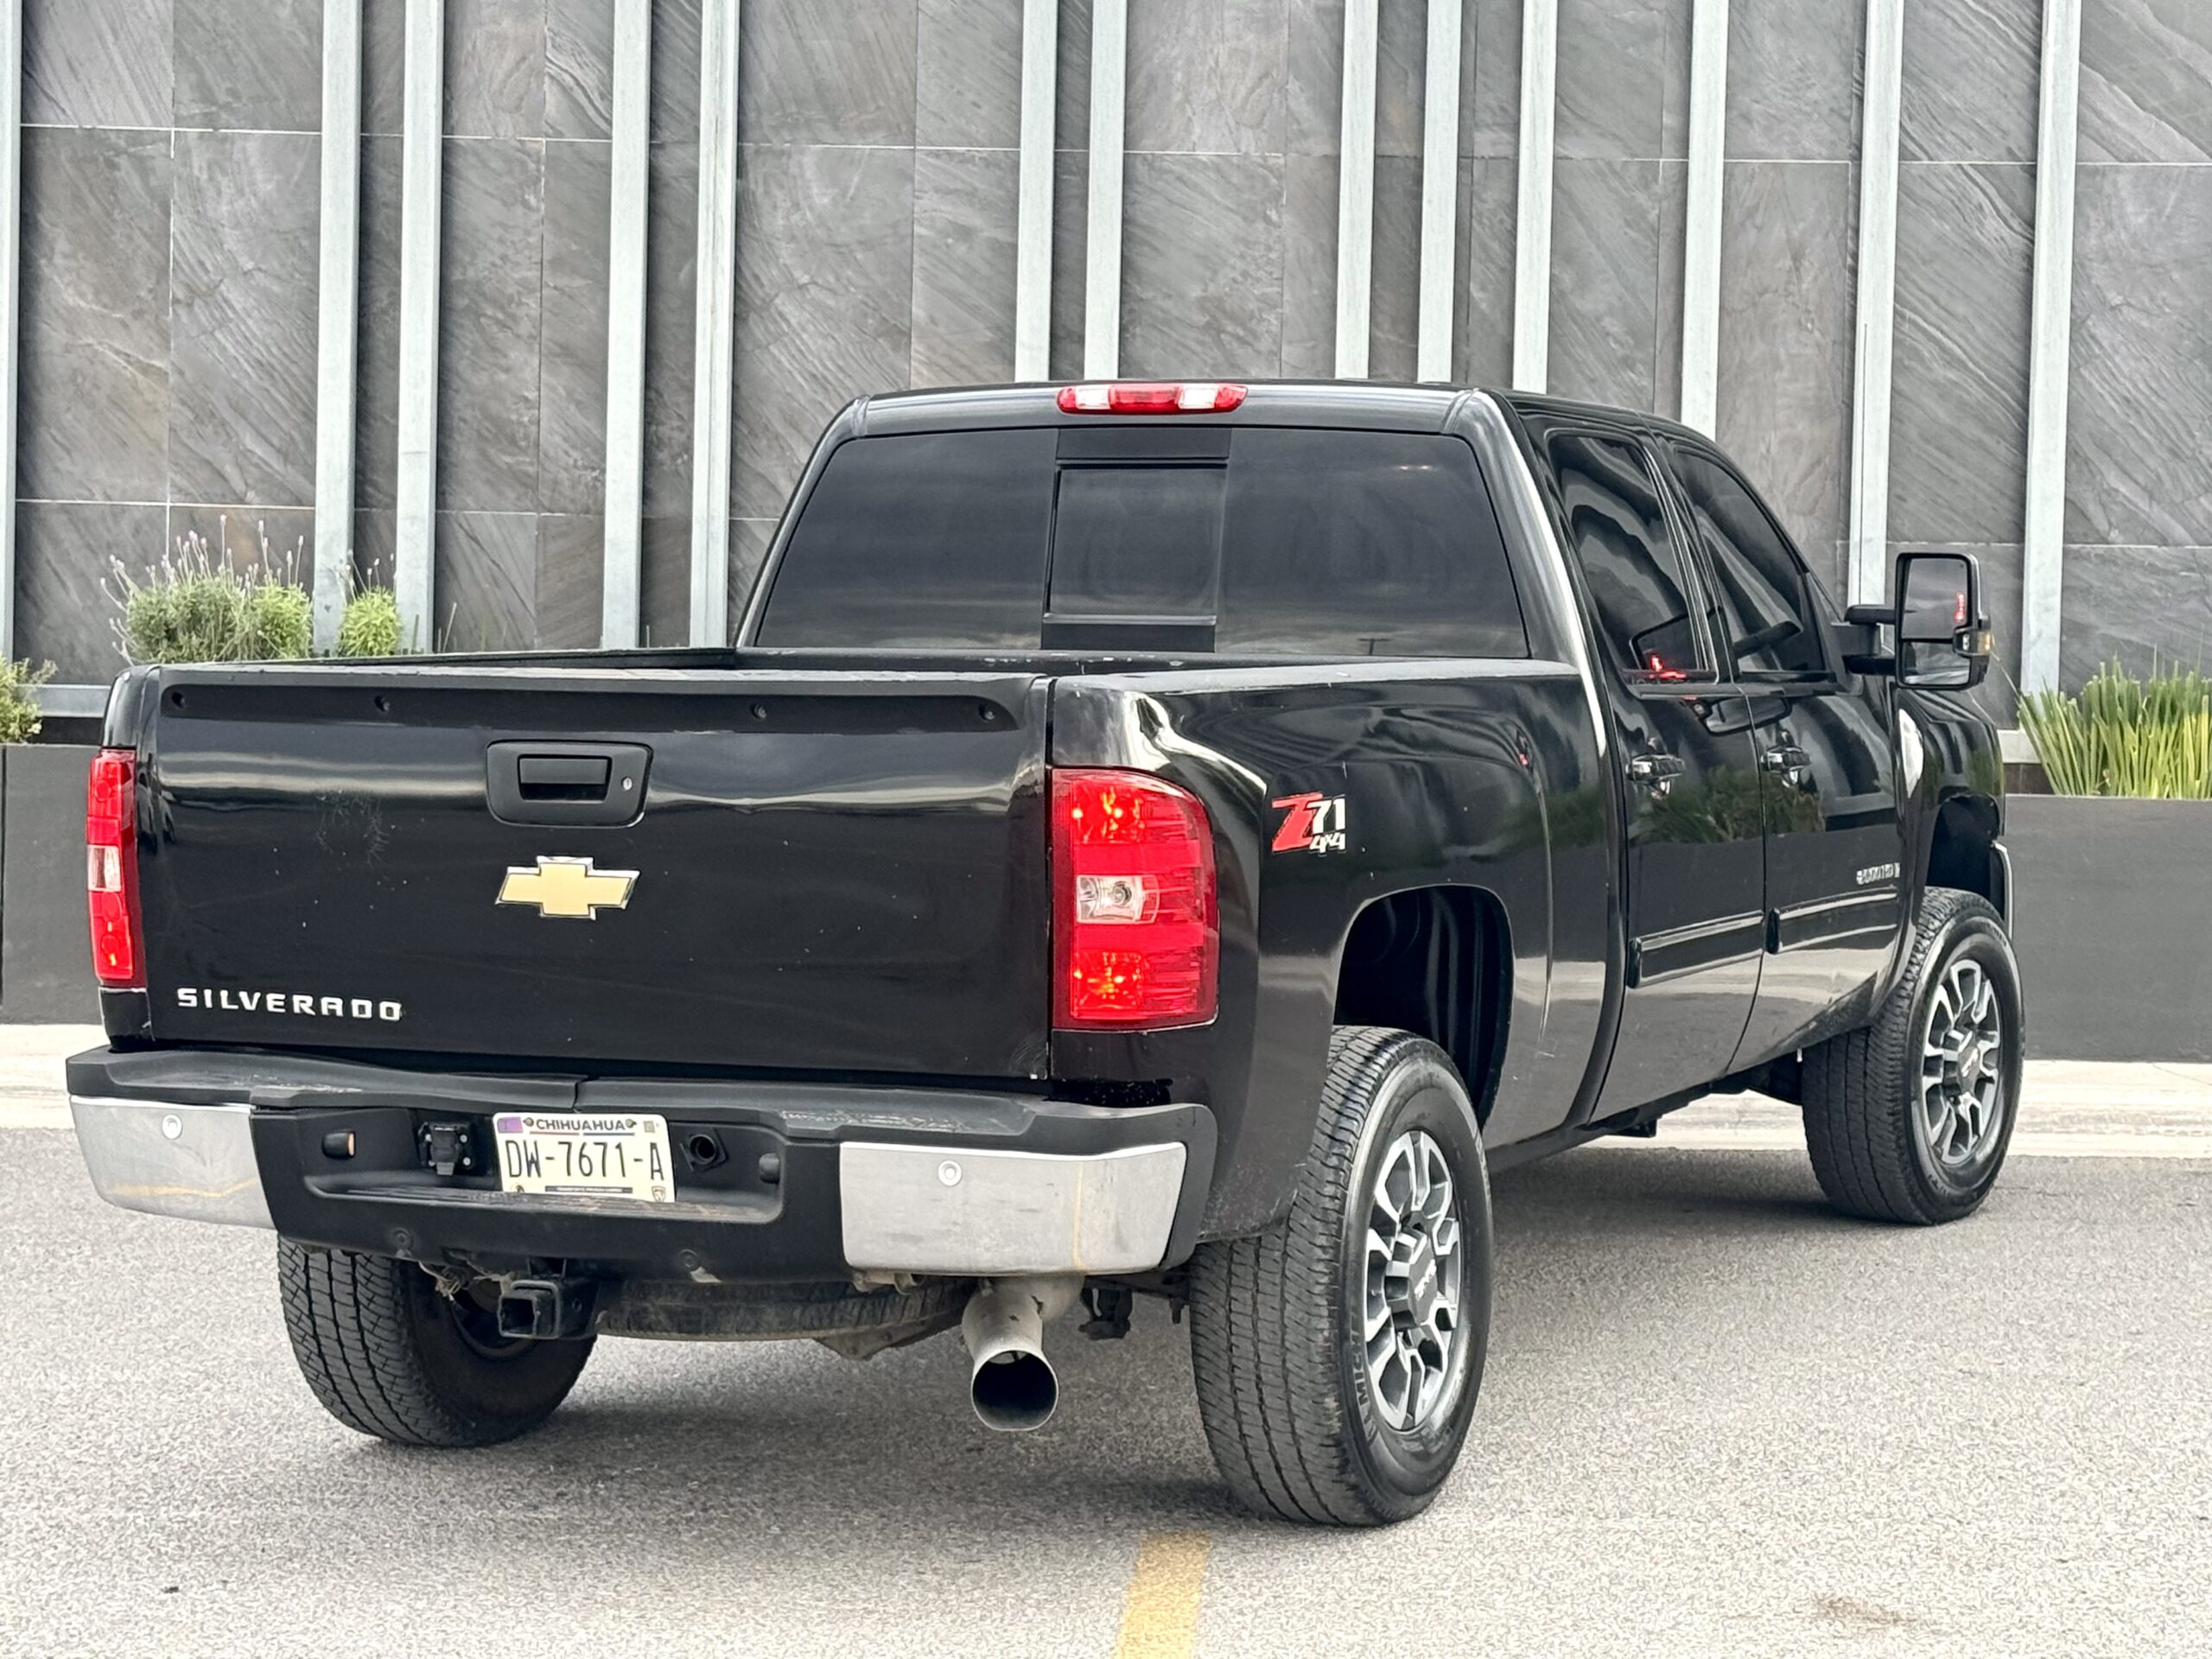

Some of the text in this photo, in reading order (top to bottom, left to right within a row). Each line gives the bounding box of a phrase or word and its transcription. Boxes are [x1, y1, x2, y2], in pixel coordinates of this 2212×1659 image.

[1271, 791, 1345, 851] Z71
[177, 988, 402, 1021] SILVERADO
[536, 1119, 626, 1131] CHIHUAHUA
[505, 1140, 664, 1181] DW-7671-A
